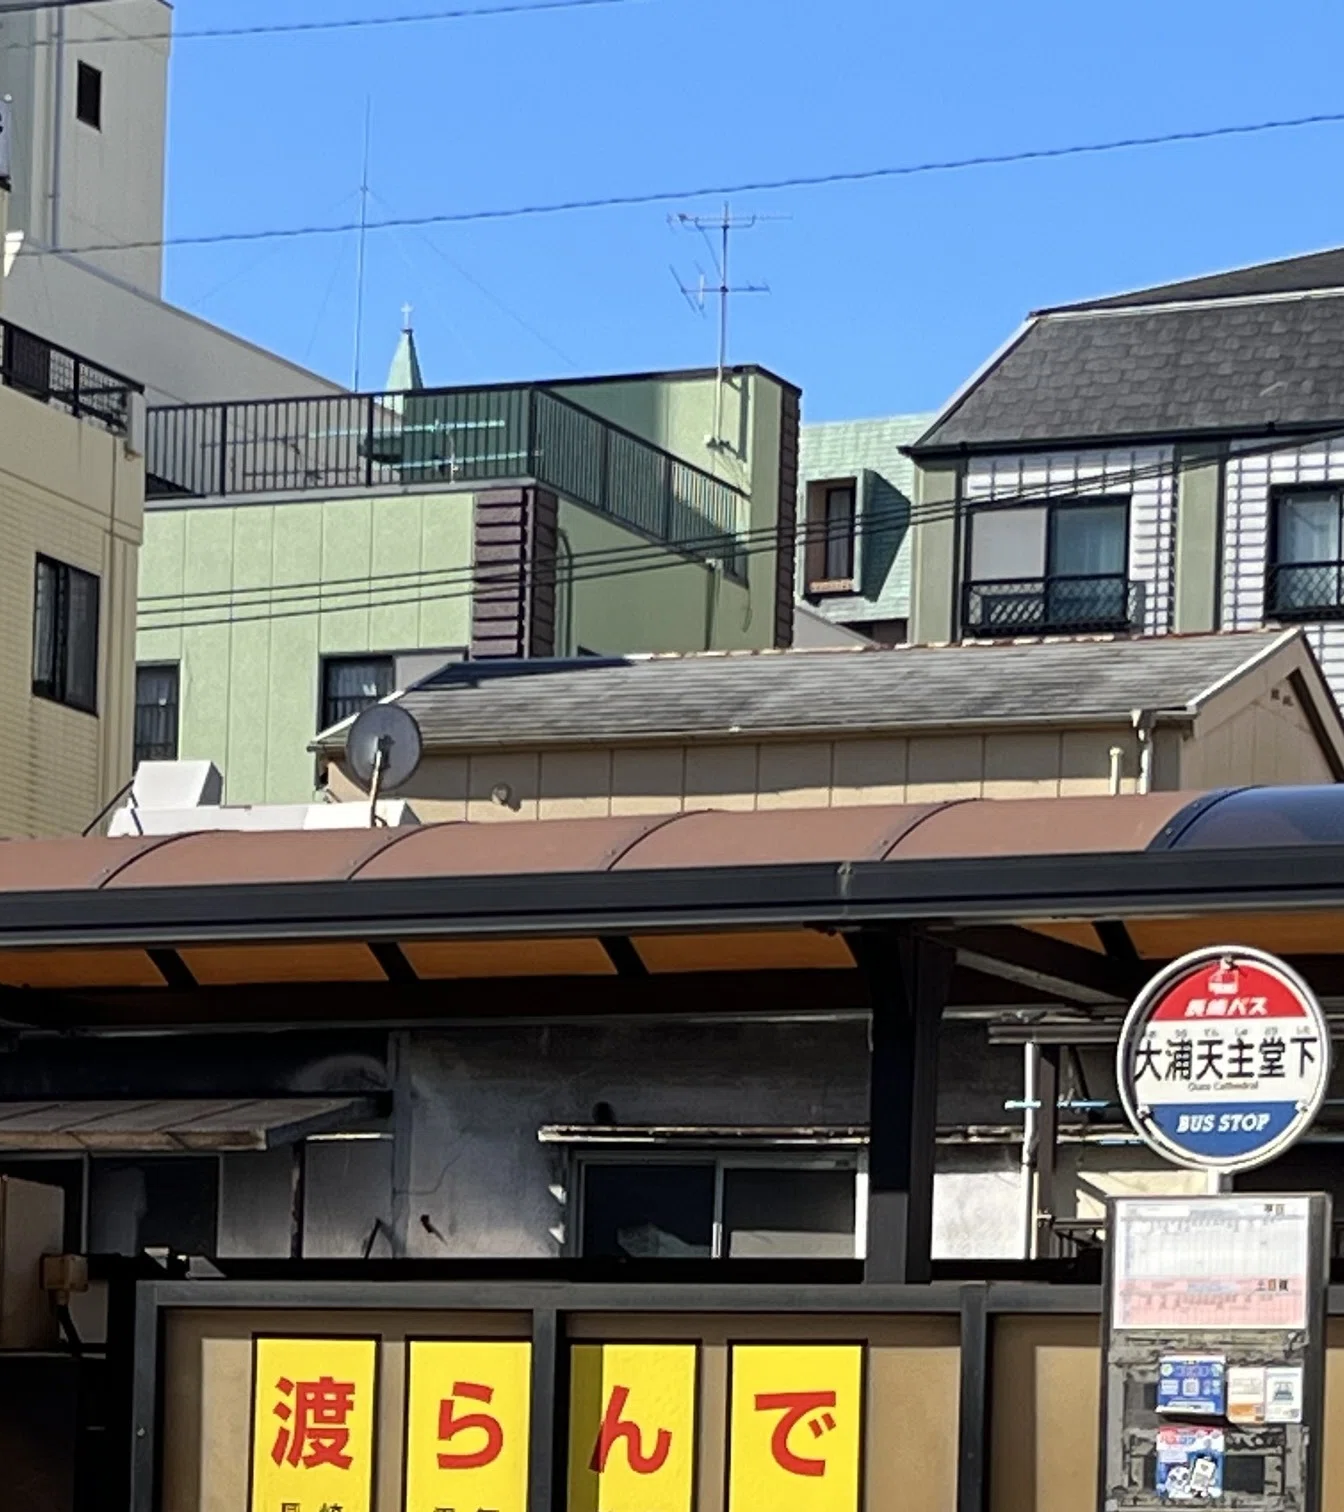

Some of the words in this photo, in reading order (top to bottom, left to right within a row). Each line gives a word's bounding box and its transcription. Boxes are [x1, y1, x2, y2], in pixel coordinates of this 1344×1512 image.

[1133, 1036, 1318, 1082] 大浦天主堂下
[1176, 1114, 1216, 1133] BUS
[1217, 1113, 1271, 1132] STOP
